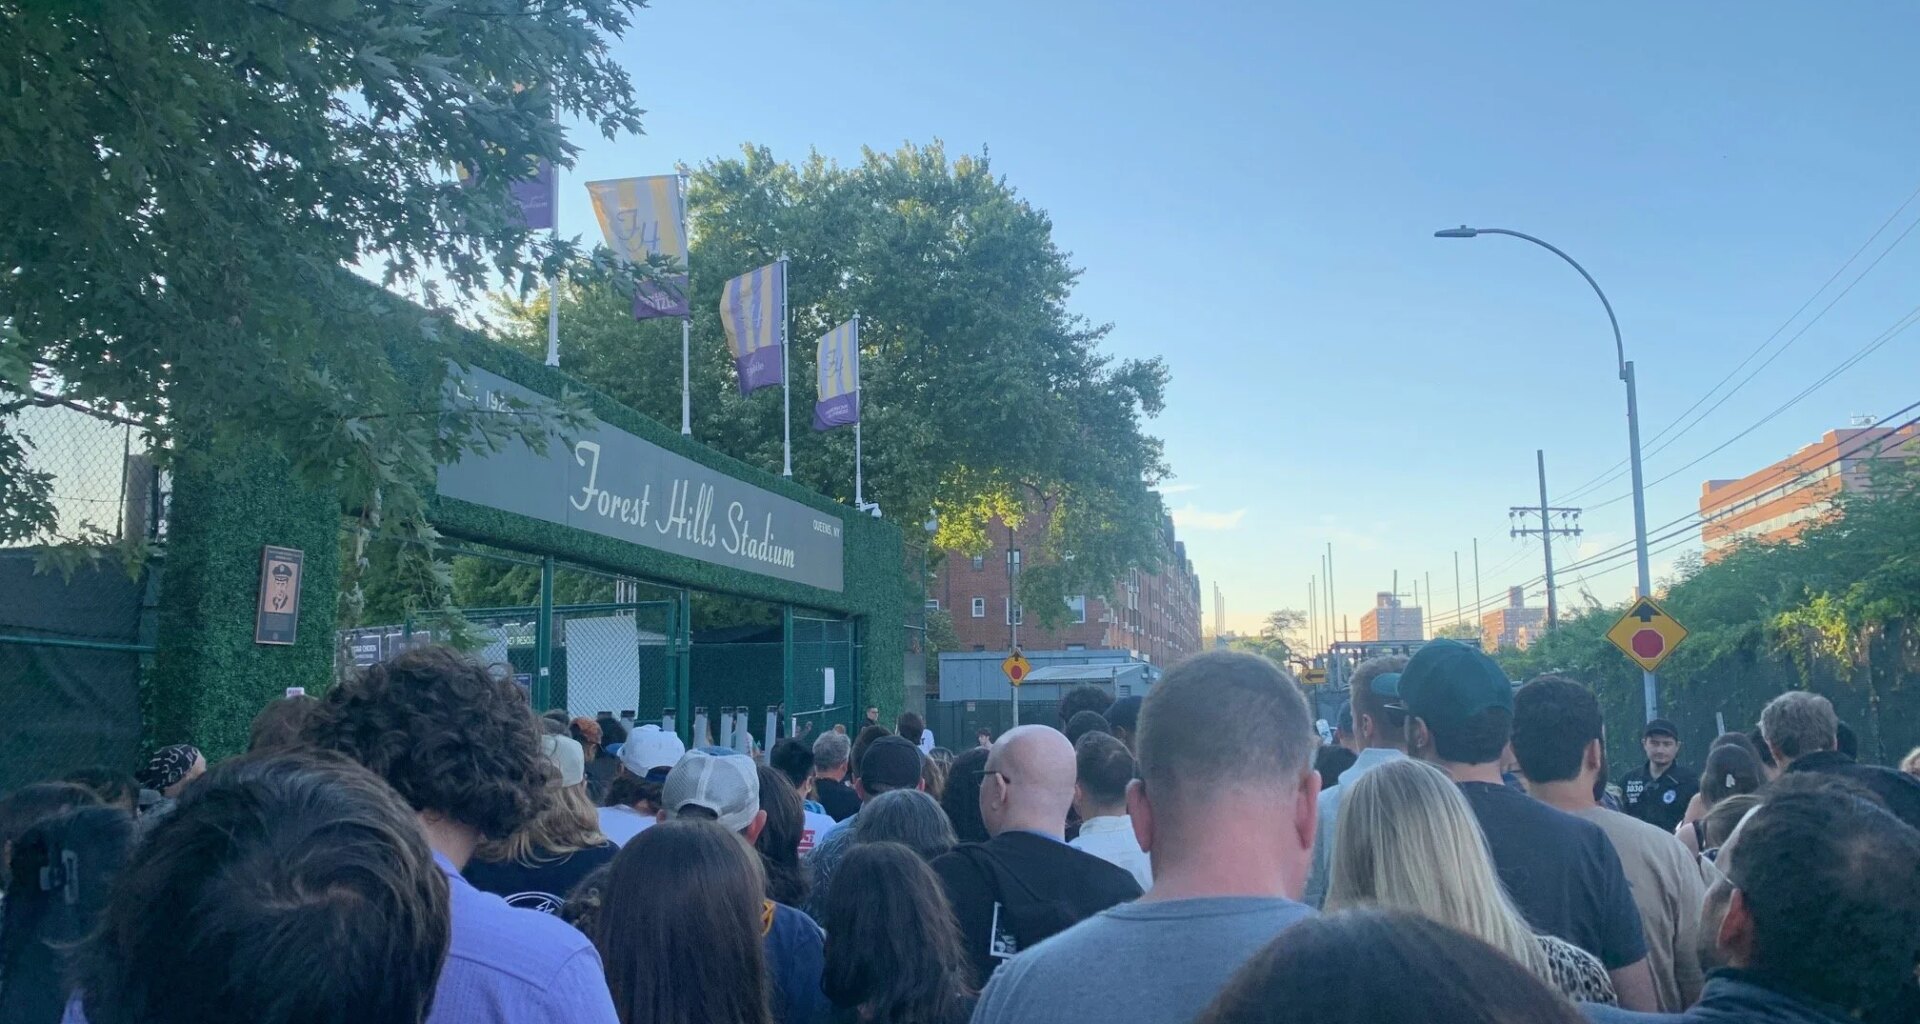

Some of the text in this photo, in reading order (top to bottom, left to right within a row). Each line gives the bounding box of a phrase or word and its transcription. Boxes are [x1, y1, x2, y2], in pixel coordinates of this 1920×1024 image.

[570, 440, 795, 568] Forest Hills Stadium
